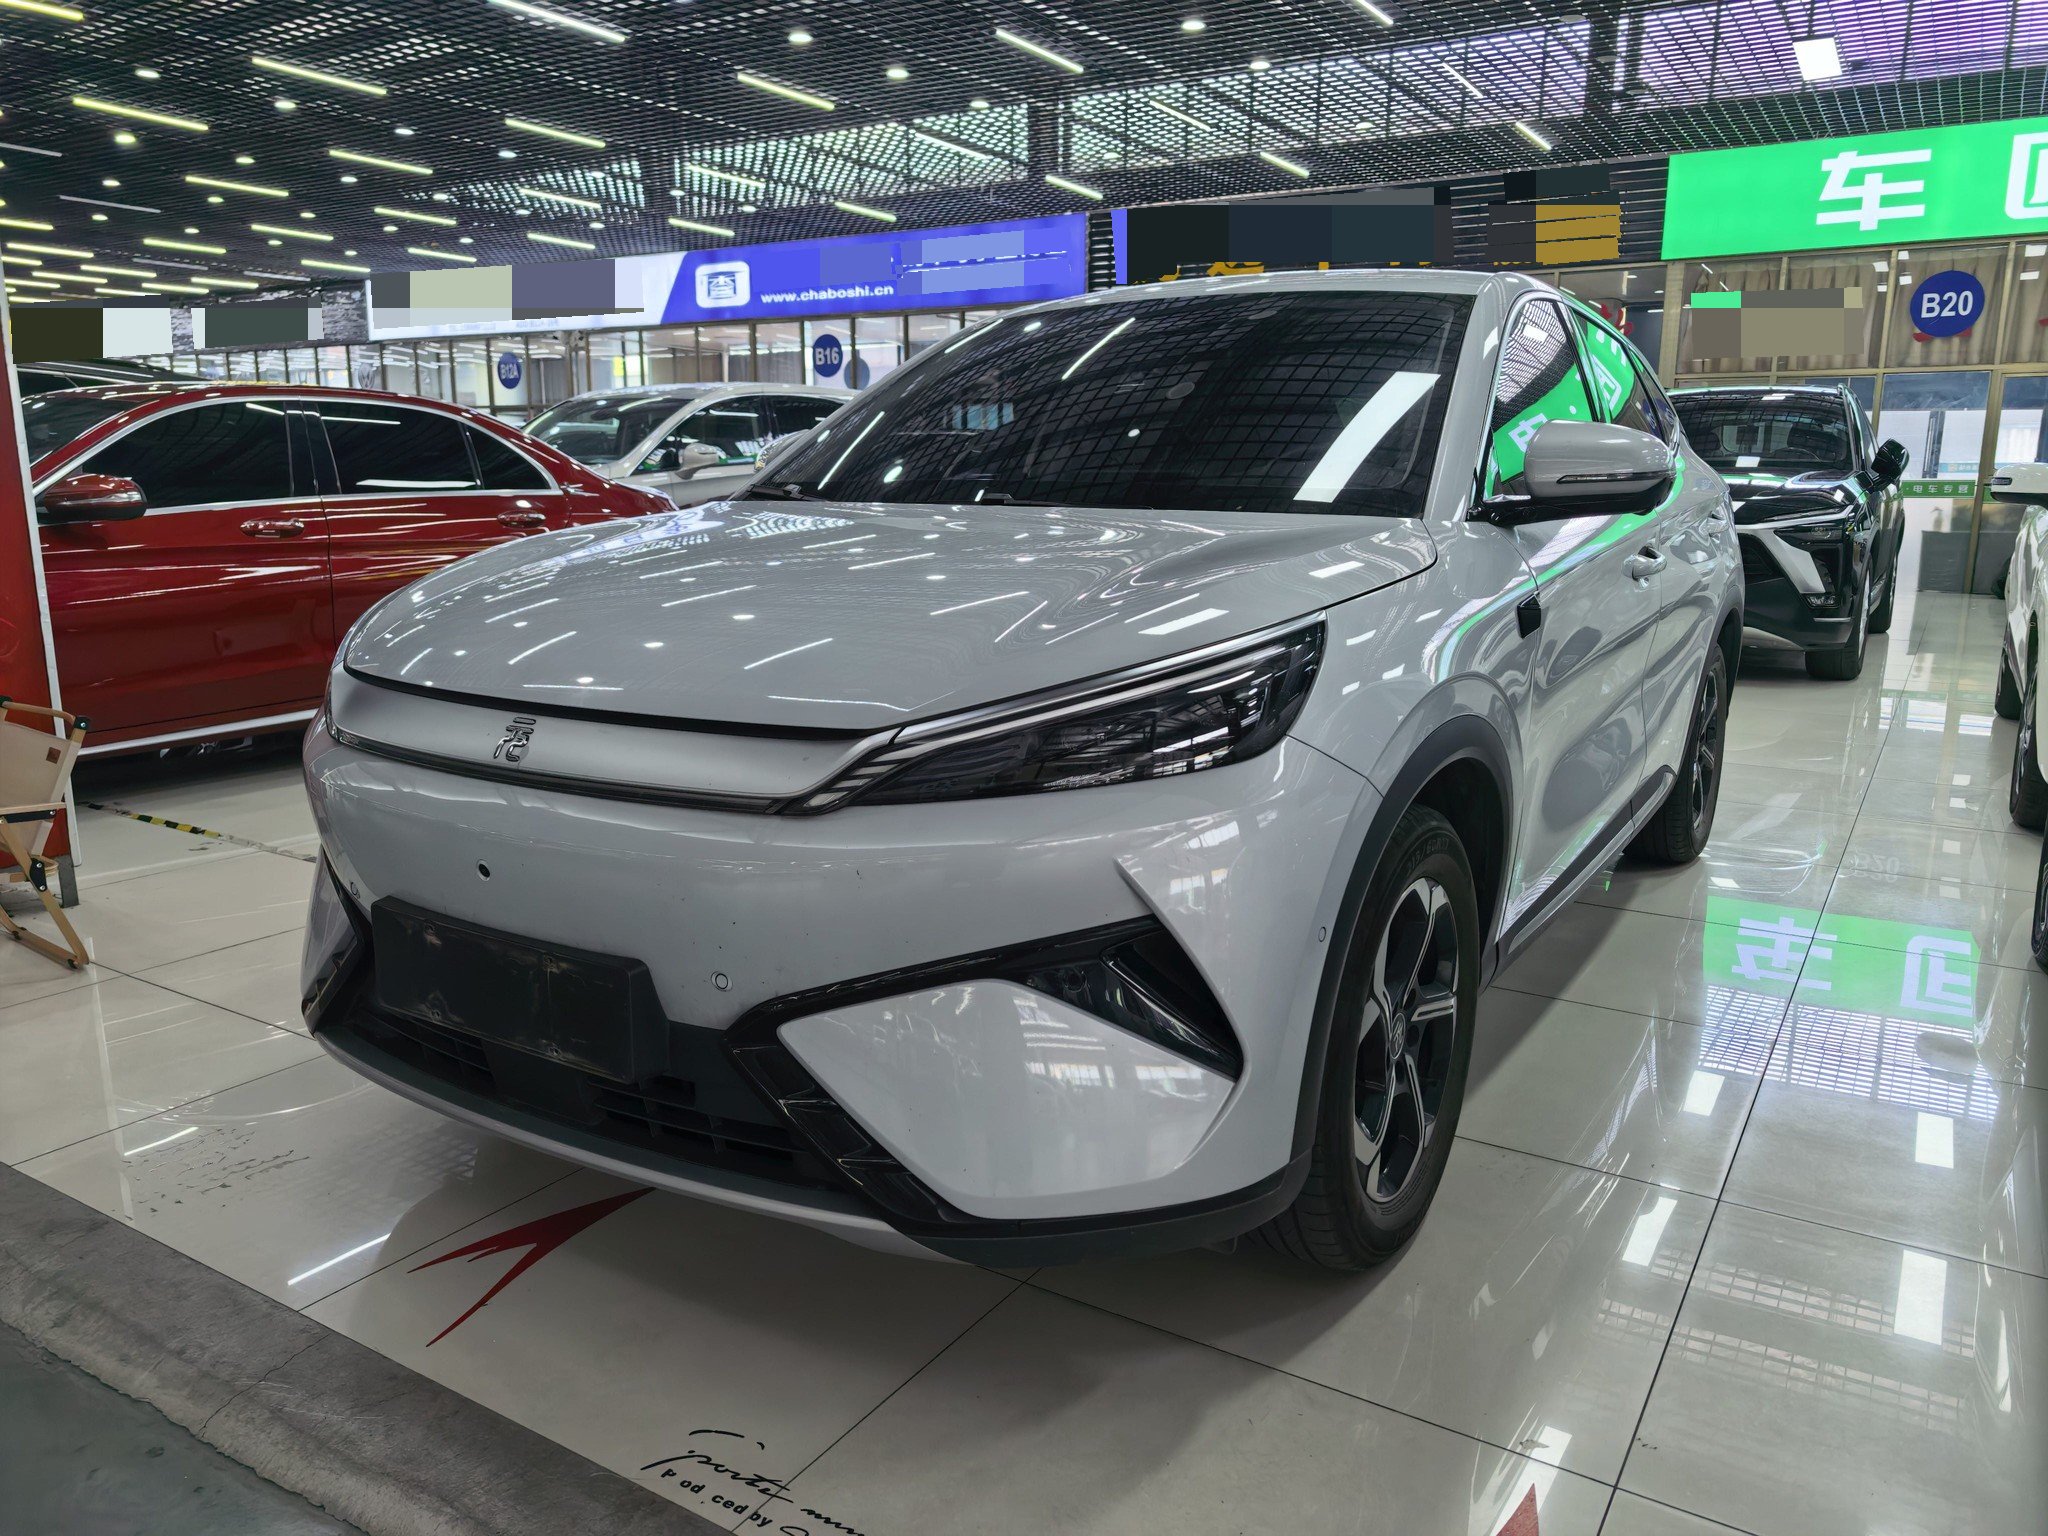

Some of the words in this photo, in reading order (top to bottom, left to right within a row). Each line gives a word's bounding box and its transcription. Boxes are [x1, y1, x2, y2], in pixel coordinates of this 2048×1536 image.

[760, 284, 894, 304] www.chaboshi.cn
[1920, 290, 1974, 319] B20
[815, 347, 840, 366] B16
